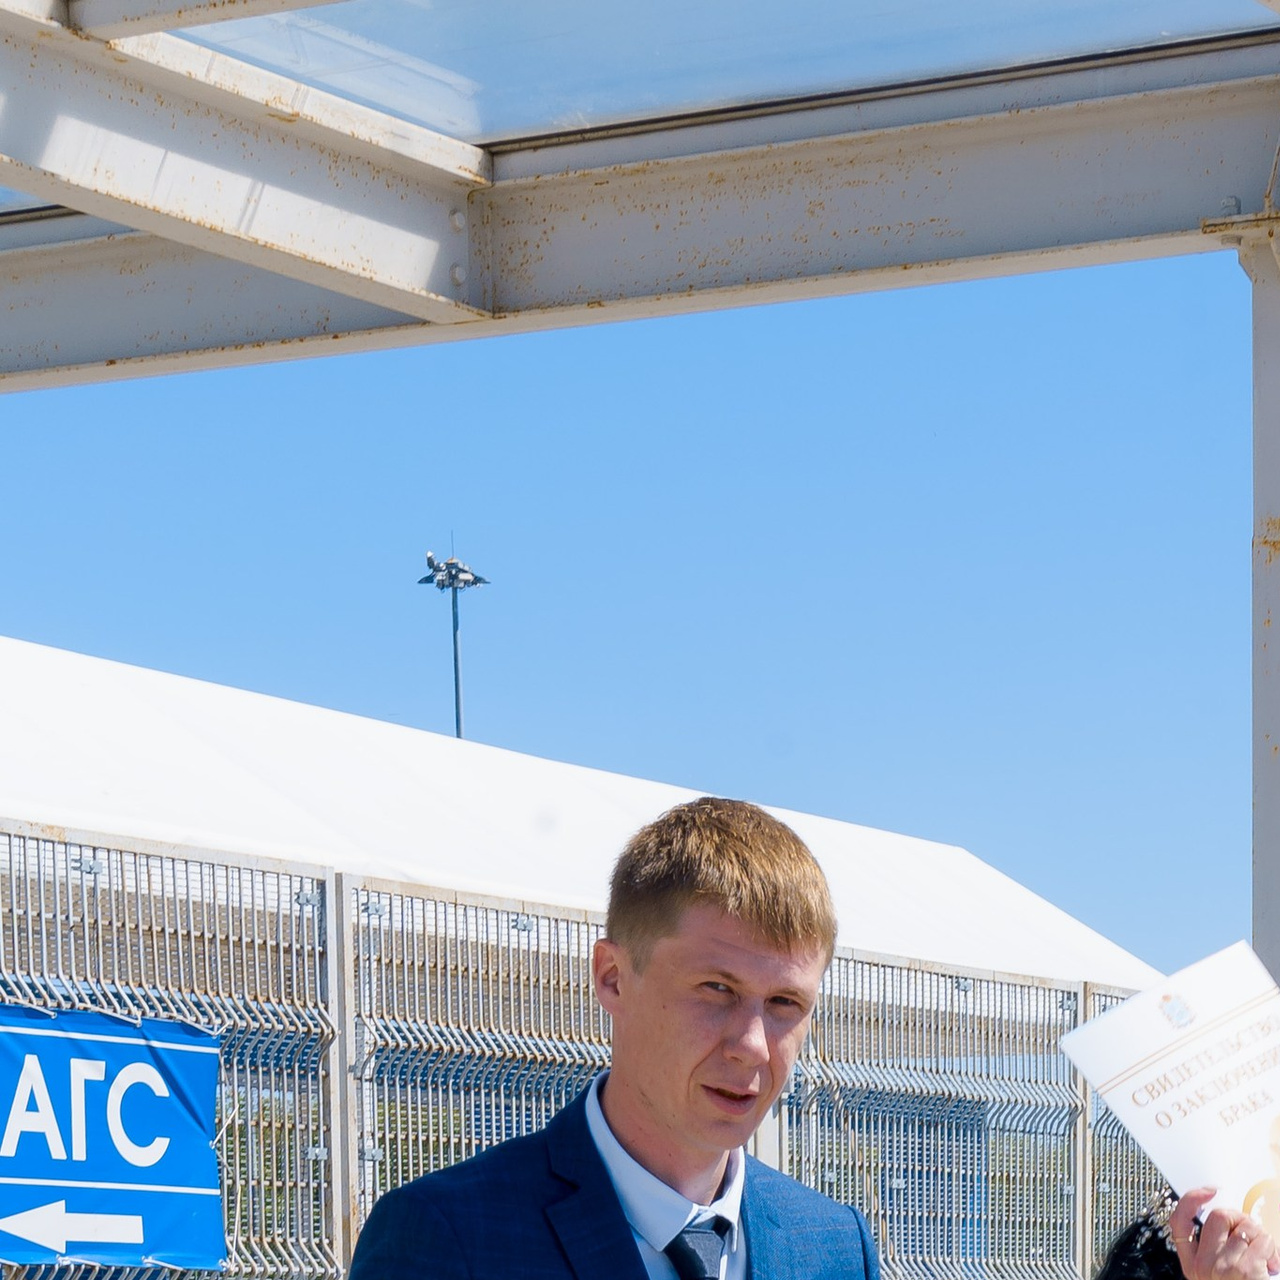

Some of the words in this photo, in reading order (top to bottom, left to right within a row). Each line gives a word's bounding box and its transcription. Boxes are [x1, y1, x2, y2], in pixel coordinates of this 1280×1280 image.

[0, 1053, 171, 1167] АГС
[1154, 1110, 1173, 1130] О
[1218, 1089, 1275, 1128] БРАКА
